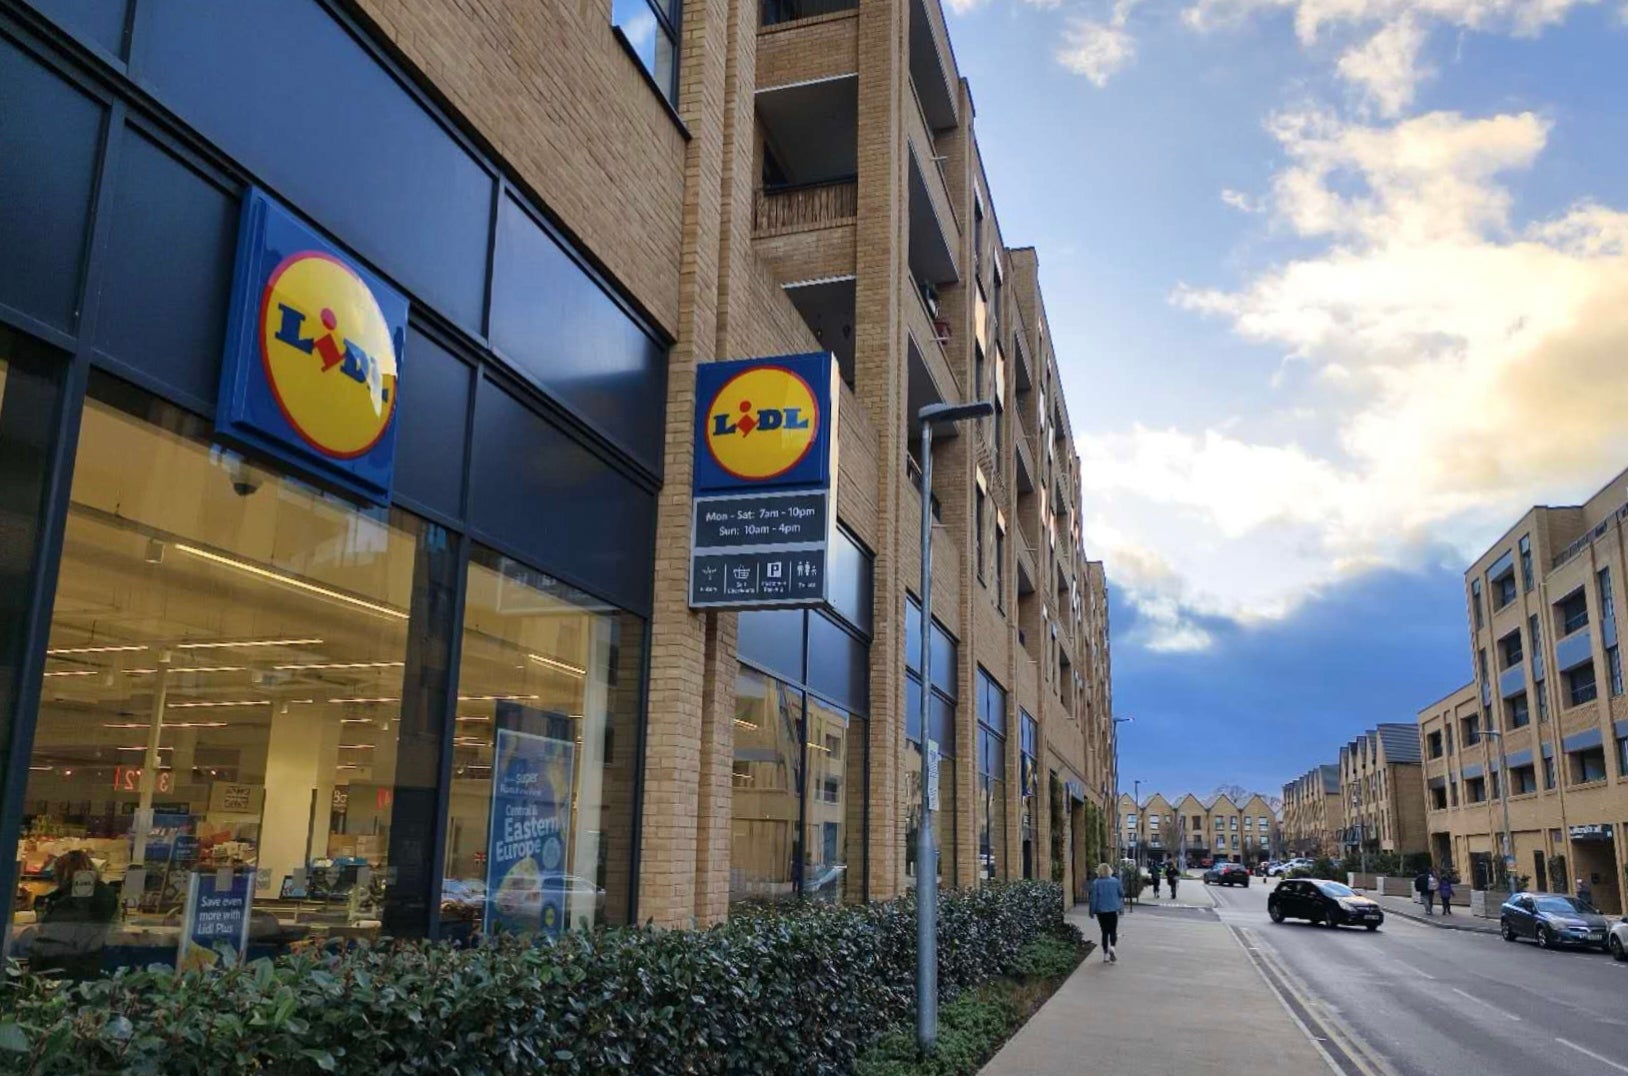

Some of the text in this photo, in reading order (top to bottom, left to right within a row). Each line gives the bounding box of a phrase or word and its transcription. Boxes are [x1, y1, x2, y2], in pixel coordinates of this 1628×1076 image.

[705, 511, 728, 523] Mon
[737, 509, 755, 521] Sat:
[759, 507, 779, 519] 7am
[788, 506, 816, 520] 10pm
[719, 524, 740, 536] Sun:
[744, 524, 770, 536] 10am
[778, 523, 801, 536] 4pm
[504, 815, 559, 843] Eastern
[496, 837, 542, 862] Europe
[201, 896, 243, 907] Save even
[199, 910, 241, 921] more with
[198, 922, 234, 935] Lidl Plus
